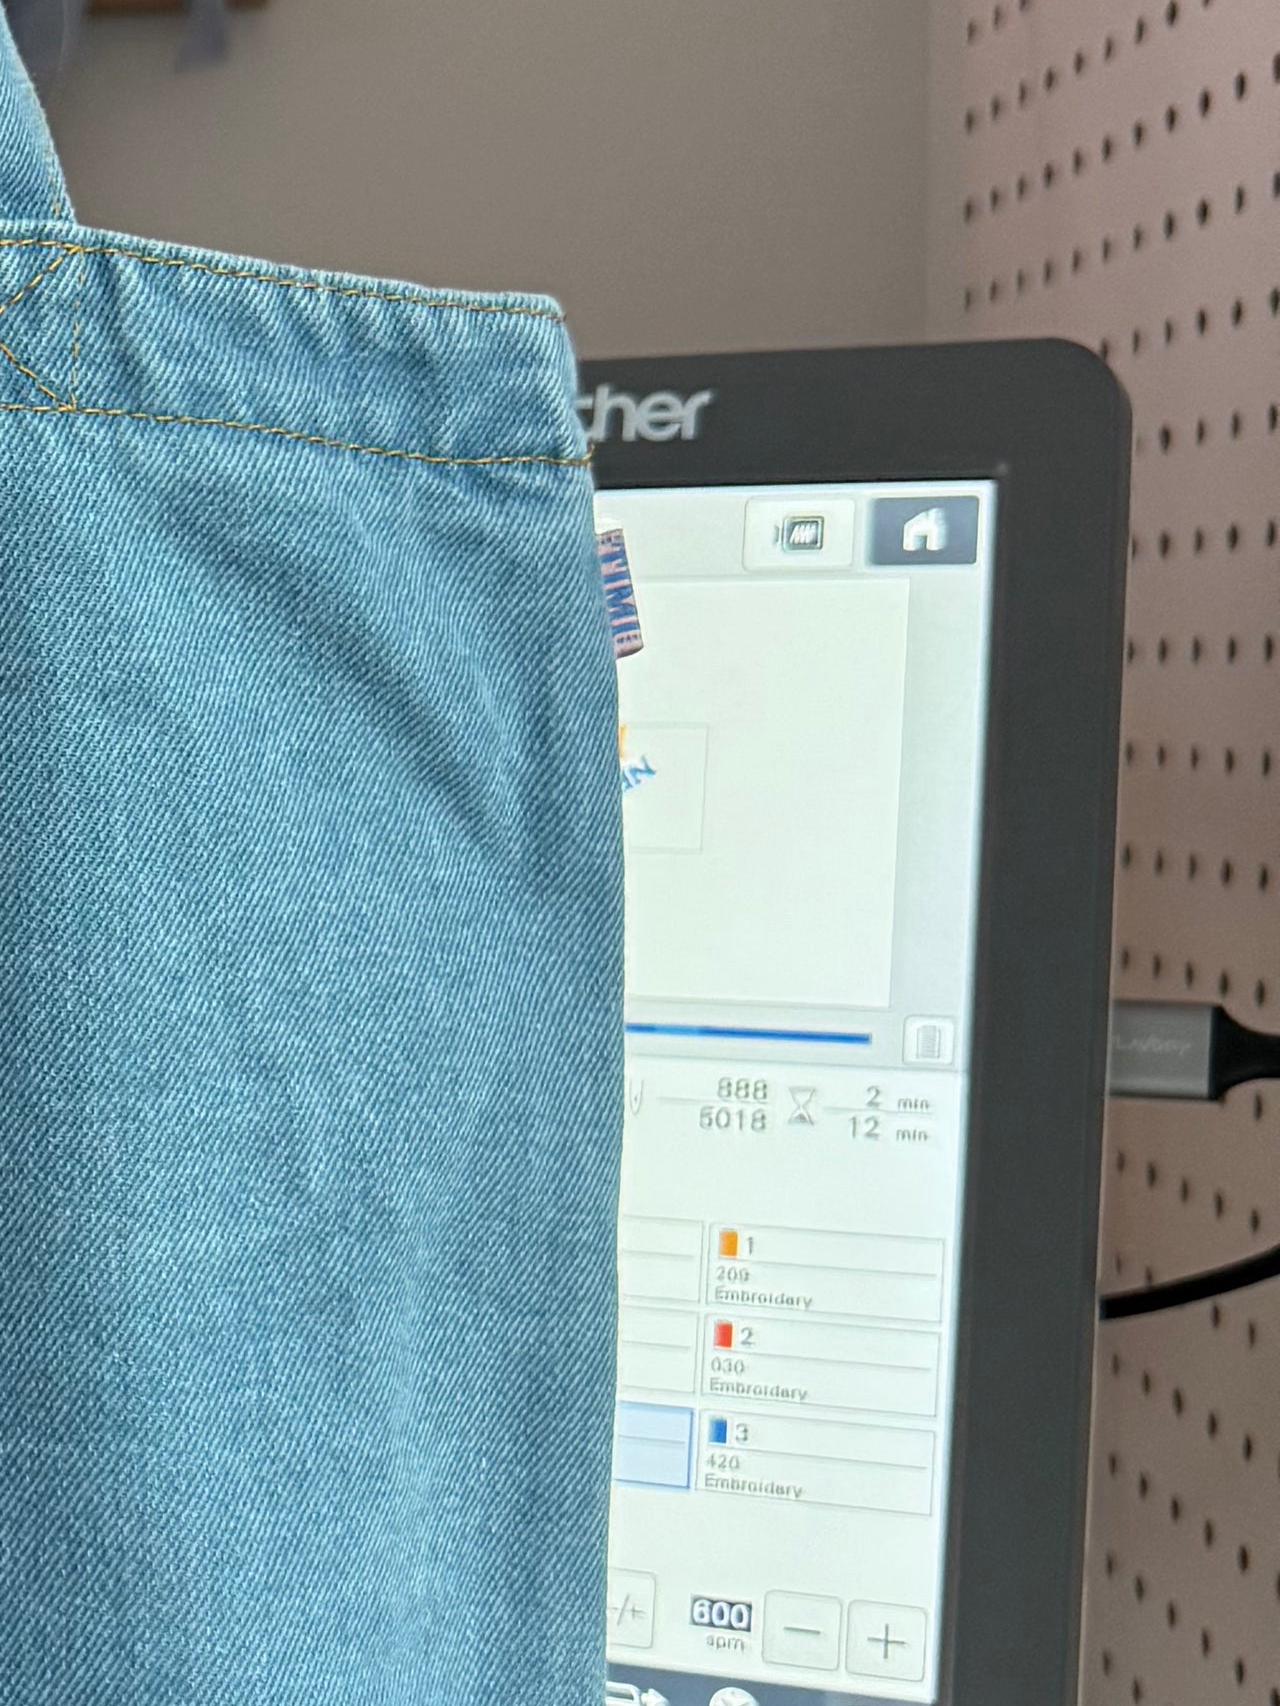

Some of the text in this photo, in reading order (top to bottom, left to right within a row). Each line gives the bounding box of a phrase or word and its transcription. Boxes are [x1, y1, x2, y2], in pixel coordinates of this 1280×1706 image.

[866, 1085, 930, 1111] 2 min
[849, 1115, 929, 1143] 12 min
[746, 1236, 755, 1256] 1
[740, 1326, 756, 1346] 2
[734, 1422, 750, 1443] 3
[691, 1598, 751, 1630] 600
